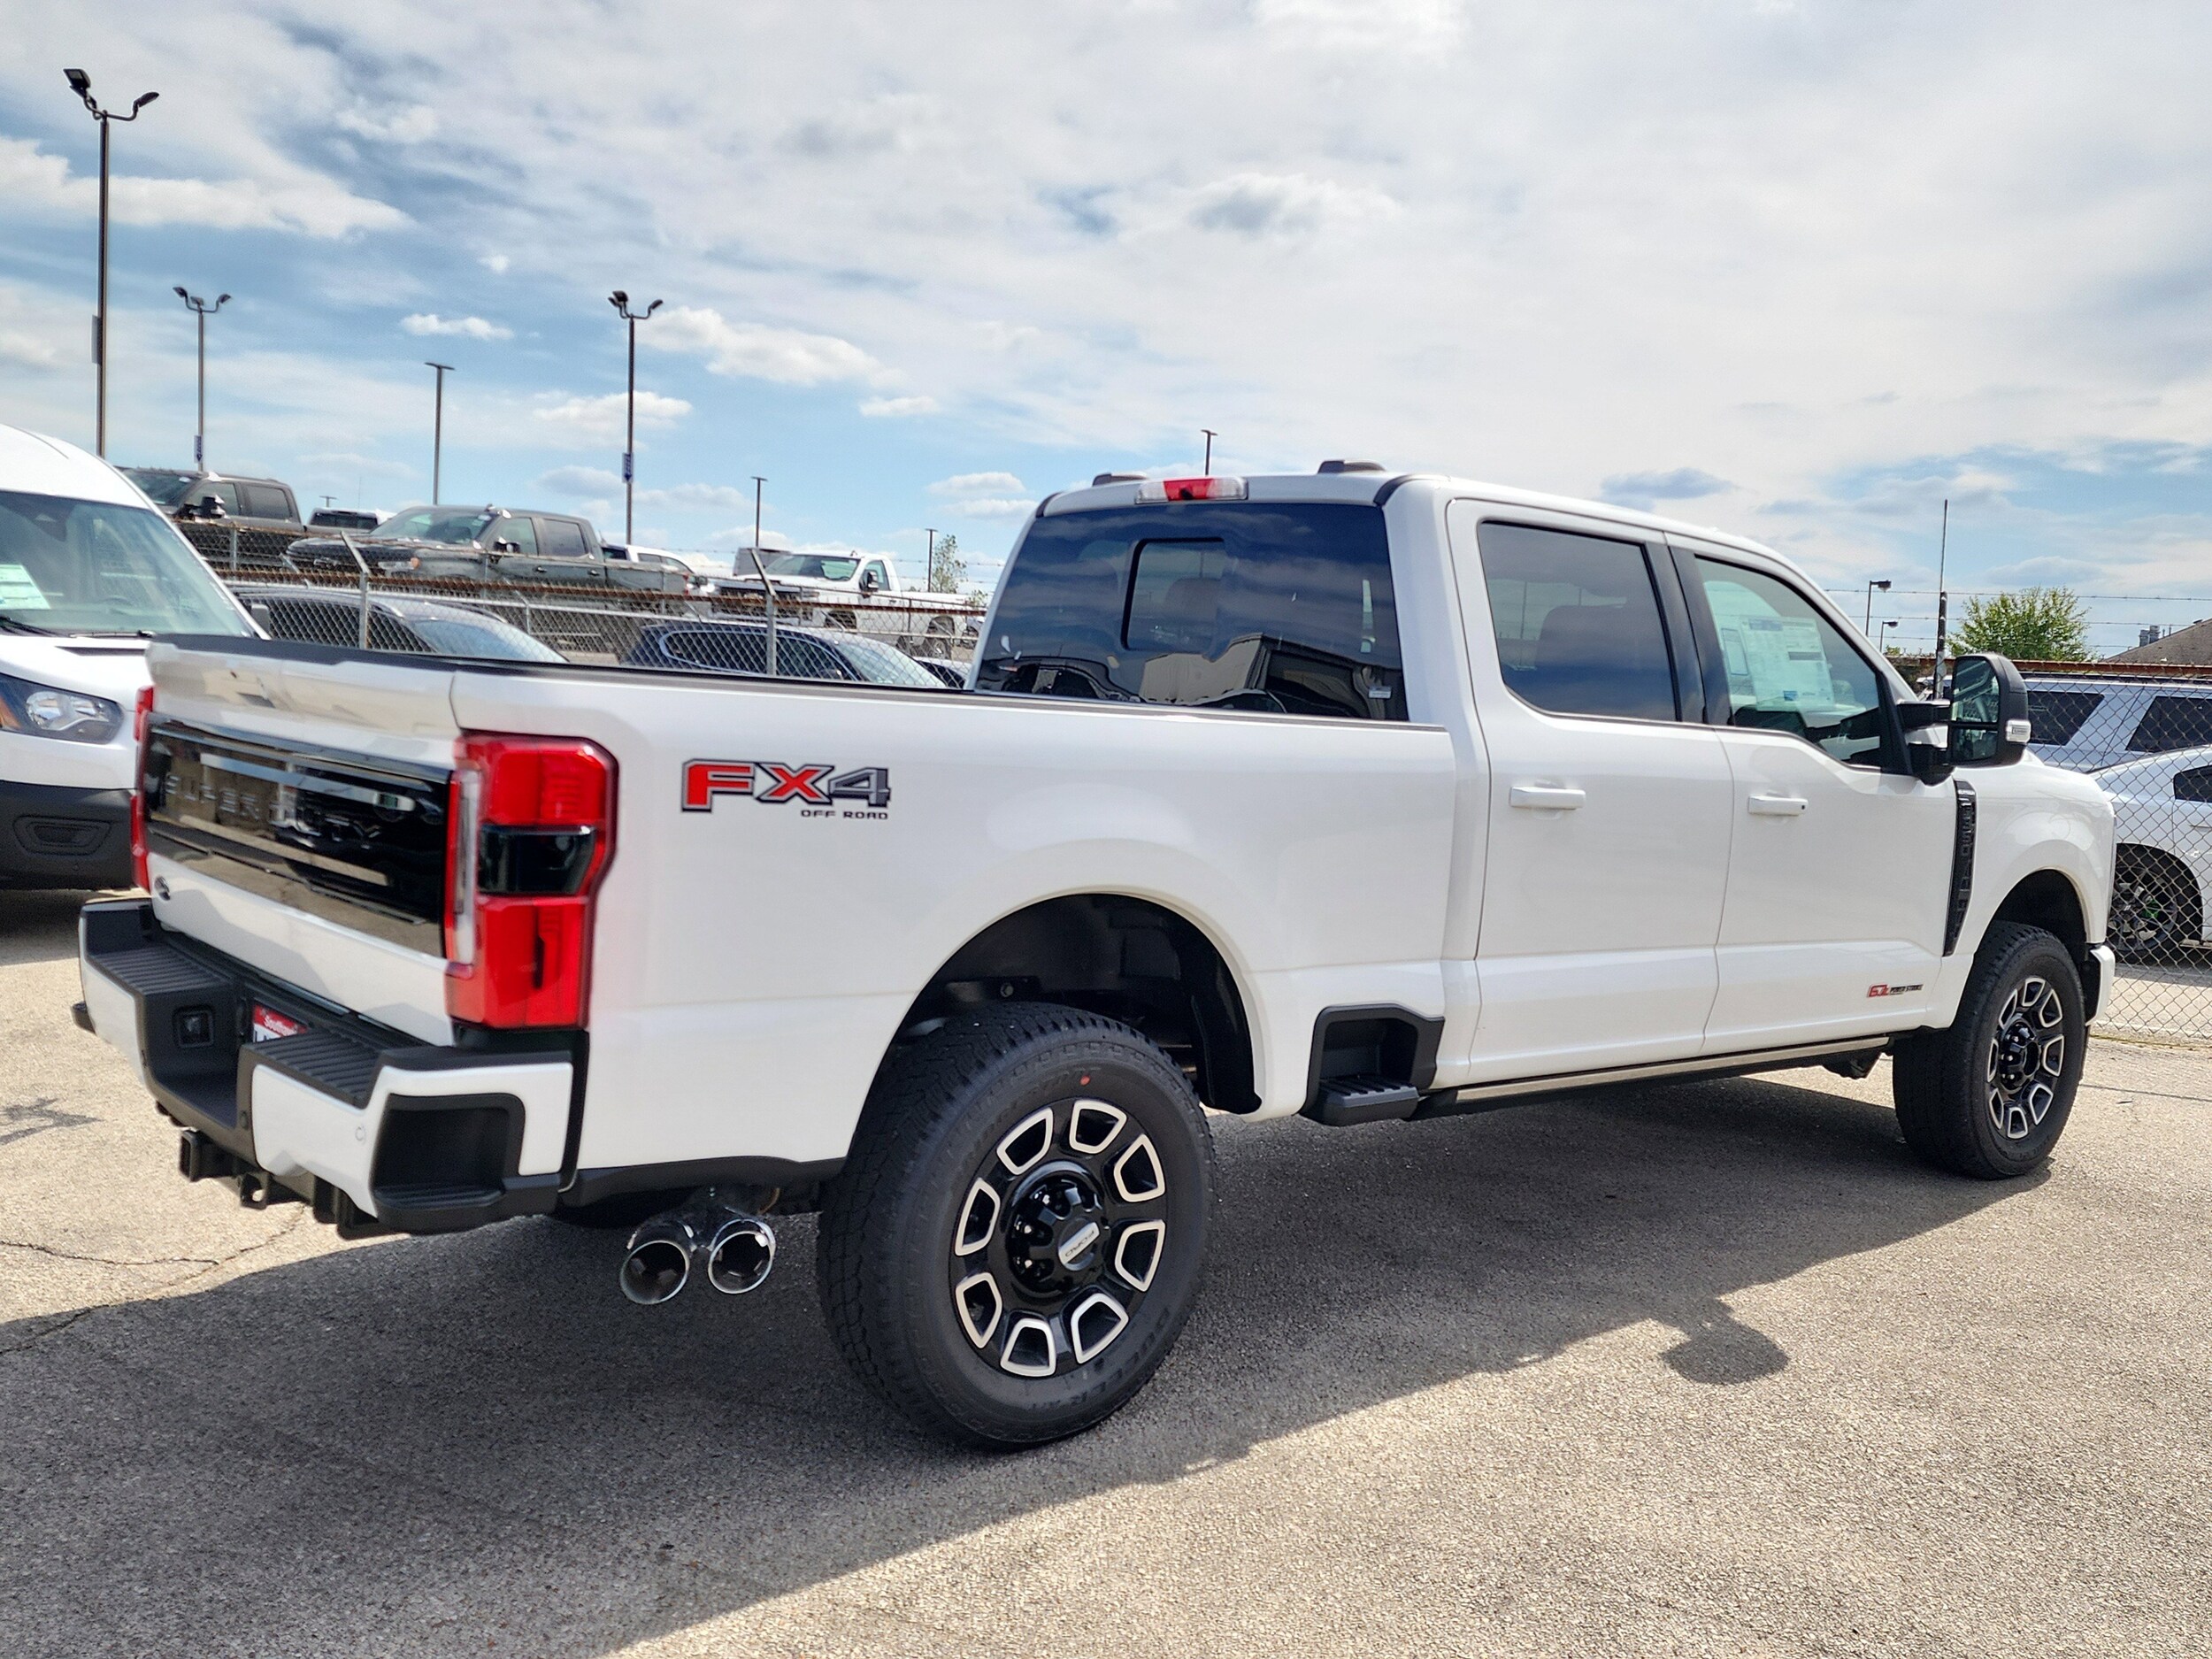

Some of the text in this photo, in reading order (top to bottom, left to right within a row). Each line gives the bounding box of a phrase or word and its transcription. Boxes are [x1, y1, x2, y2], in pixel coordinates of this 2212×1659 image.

[681, 758, 891, 813] FX4
[800, 809, 889, 820] OFF ROAD
